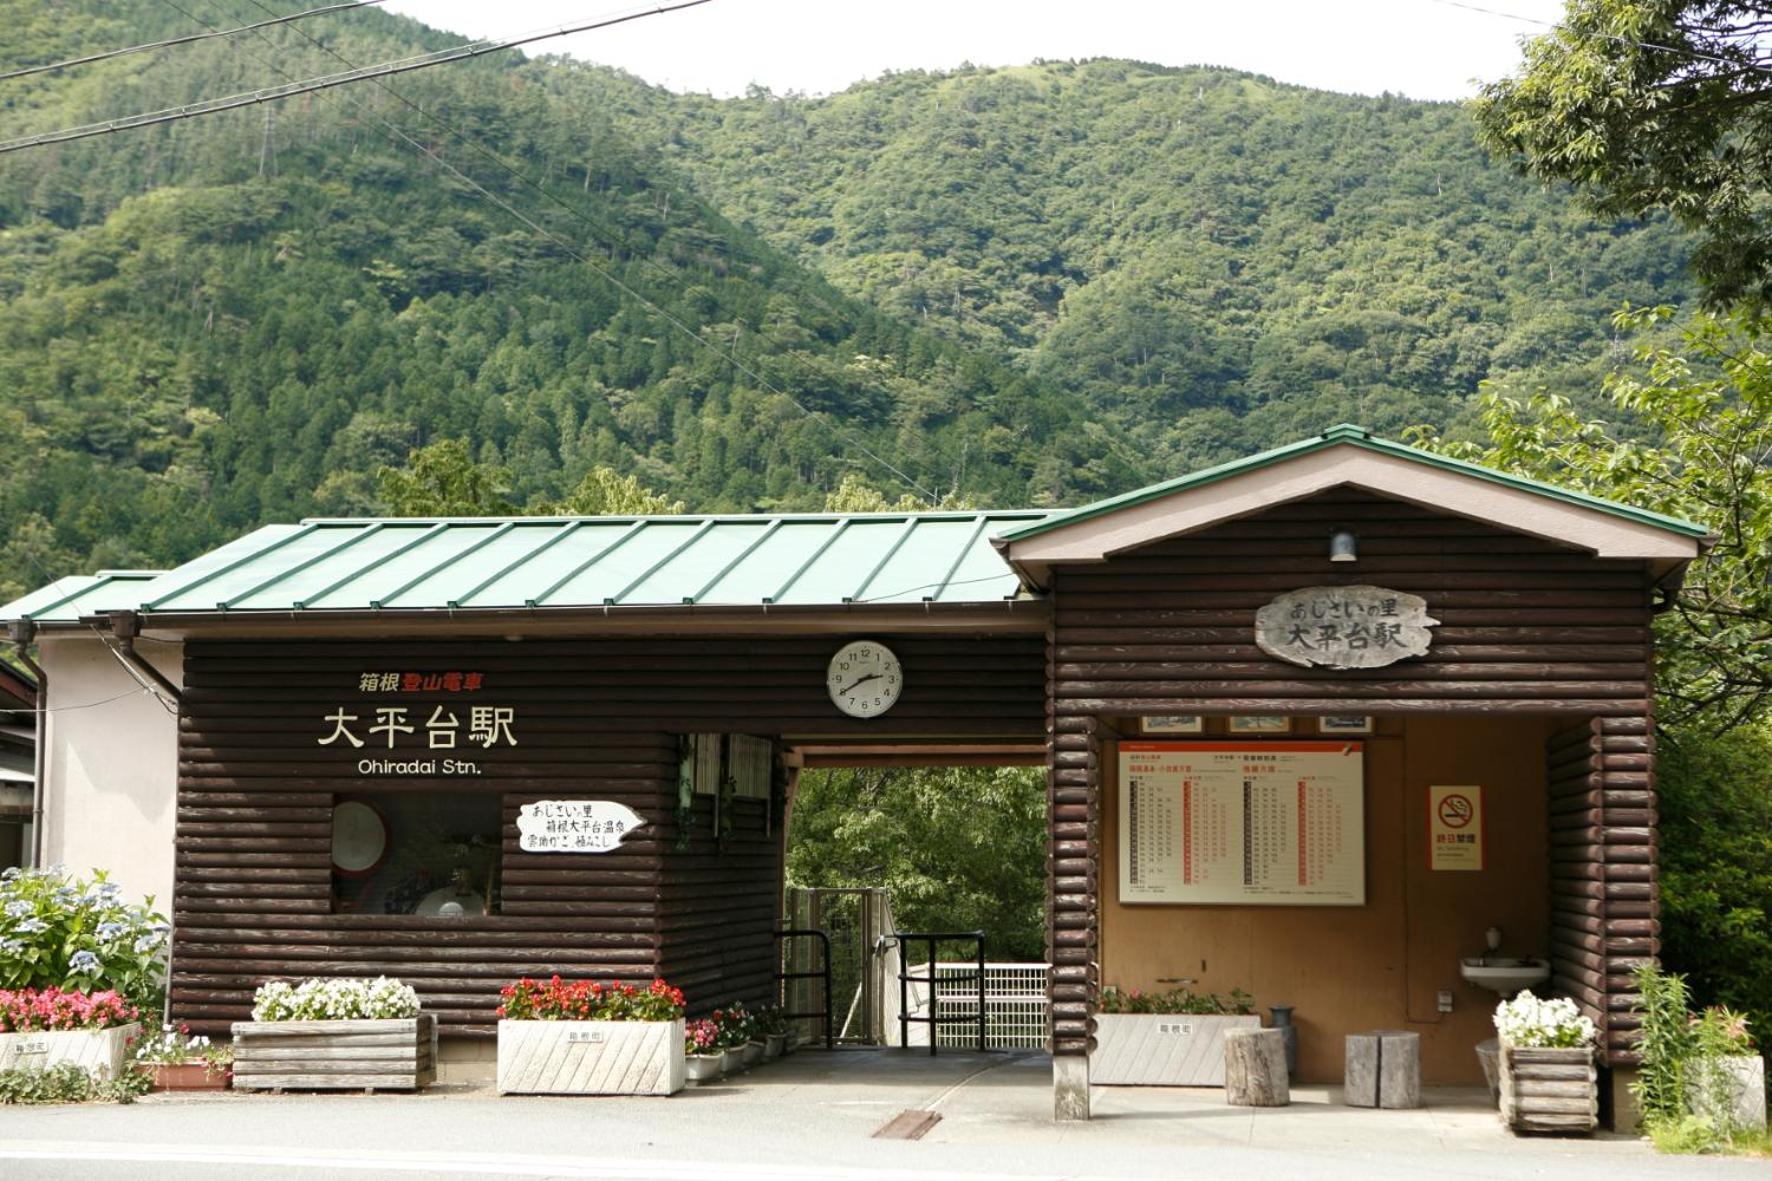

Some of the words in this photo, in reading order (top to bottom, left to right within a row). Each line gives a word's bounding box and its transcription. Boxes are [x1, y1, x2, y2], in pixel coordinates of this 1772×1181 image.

[1290, 598, 1399, 619] あじさいの里
[1286, 622, 1408, 651] 大平台駅
[849, 653, 857, 661] 11
[860, 649, 870, 657] 12
[840, 662, 849, 671] 10
[884, 662, 890, 670] 2
[359, 672, 484, 692] 箱根登山電車
[835, 675, 842, 683] 9
[888, 675, 895, 684] 3
[884, 688, 890, 696] 4
[861, 701, 868, 709] 6
[317, 704, 519, 749] 大平台駅
[358, 759, 436, 775] Ohiradai
[442, 759, 482, 775] Stn.
[546, 819, 625, 834] 箱根大平台温泉
